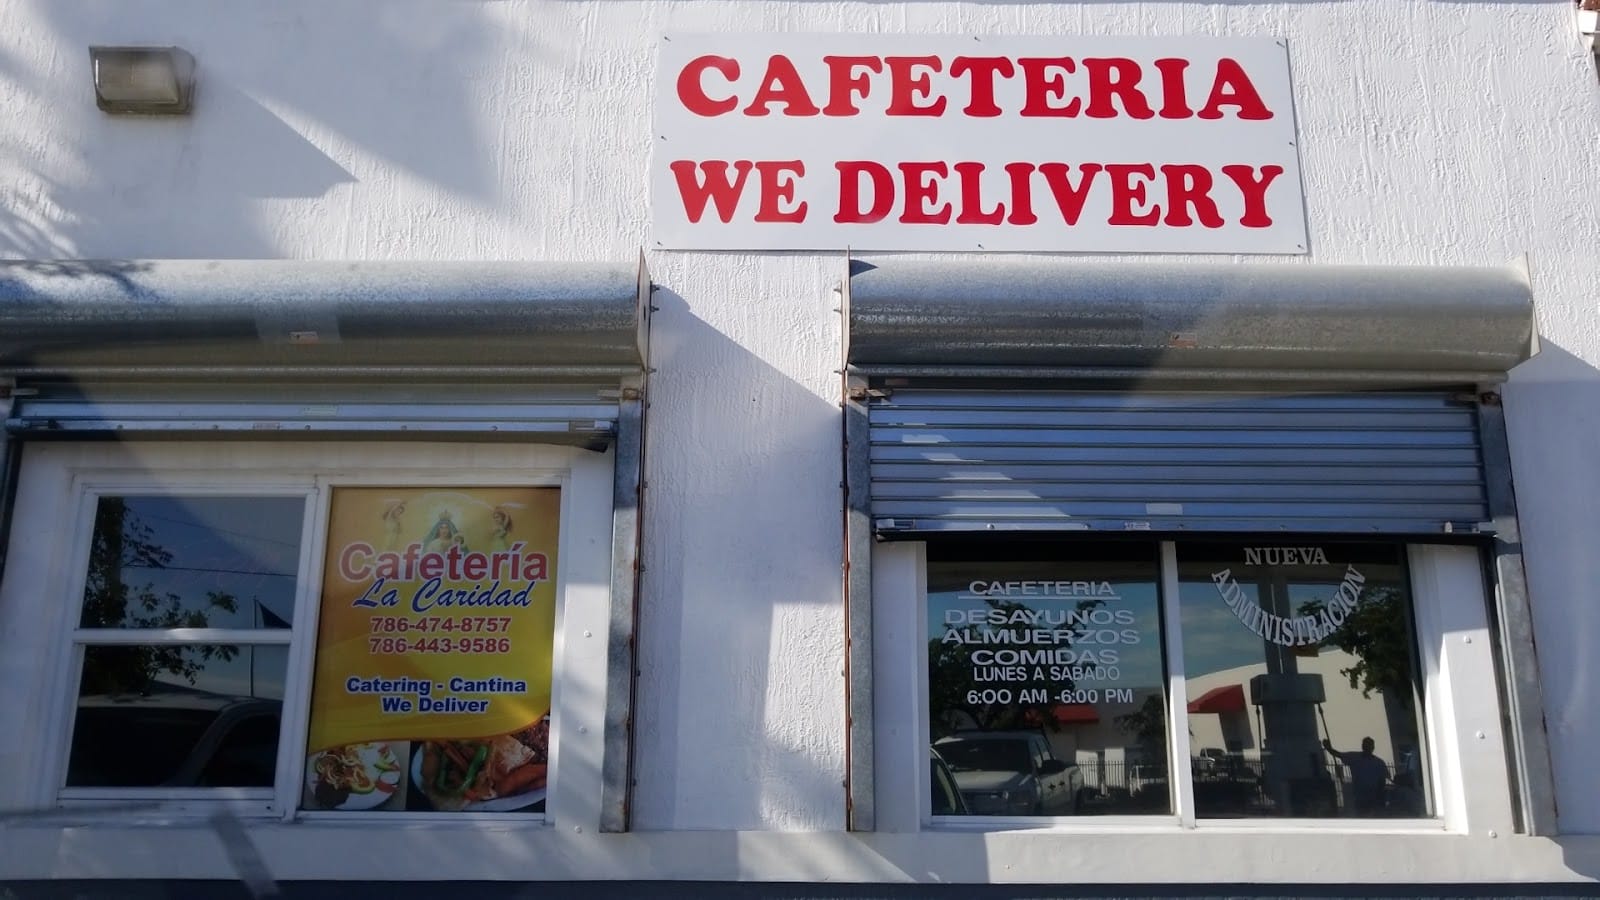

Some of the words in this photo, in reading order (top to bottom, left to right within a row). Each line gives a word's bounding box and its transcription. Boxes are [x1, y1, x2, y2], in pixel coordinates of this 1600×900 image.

[676, 54, 1275, 120] CAFETERIA
[670, 159, 808, 224] WE
[834, 160, 1284, 228] DELIVERY
[340, 542, 549, 582] Cafetería
[1243, 547, 1330, 566] NUEVA
[352, 577, 400, 608] La
[412, 577, 536, 613] Caridad
[968, 580, 1115, 596] CAFETERIA
[1211, 563, 1366, 647] ADMINISTRACION
[370, 616, 512, 633] 786-474-8757
[944, 609, 1135, 625] DESAYUNOS
[941, 628, 1141, 645] ALMUERZOS
[369, 637, 511, 654] 786-443-9586
[970, 649, 1120, 666] COMIDAS
[973, 666, 1028, 682] LUNES
[1032, 666, 1045, 681] A
[1050, 666, 1120, 681] SABADO
[346, 677, 431, 695] Catering
[449, 678, 526, 693] Cantina
[381, 697, 412, 713] We
[418, 697, 488, 713] Deliver
[966, 688, 1012, 705] 6:00
[1017, 688, 1048, 704] AM
[1104, 688, 1134, 703] PM
